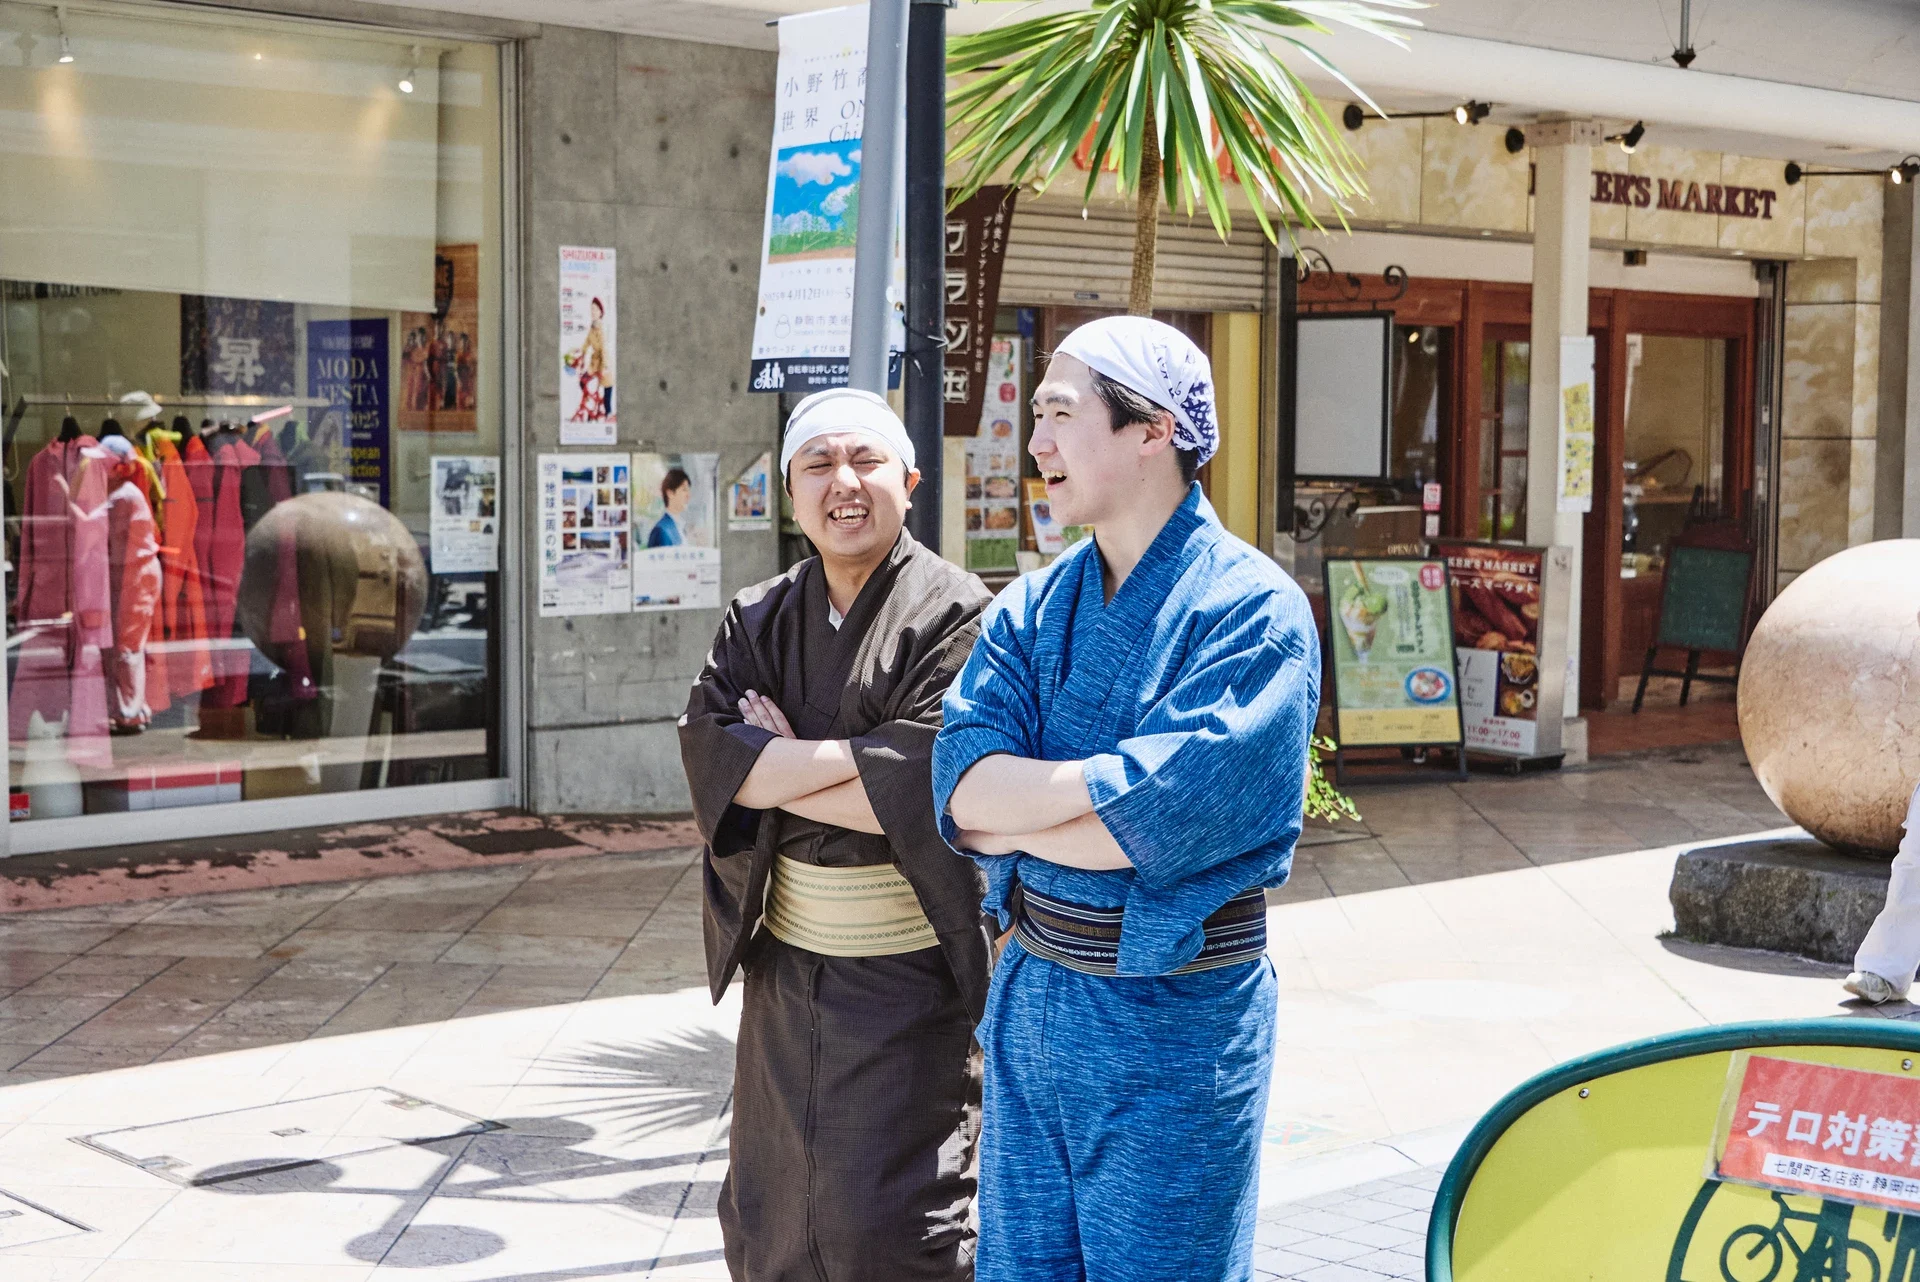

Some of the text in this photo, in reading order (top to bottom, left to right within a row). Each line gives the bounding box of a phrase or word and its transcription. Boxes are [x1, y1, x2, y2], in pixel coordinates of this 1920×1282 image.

[781, 106, 819, 132] 世界
[1590, 170, 1777, 219] ER'S MARKET
[316, 357, 379, 380] MODA
[317, 384, 379, 406] FESTA
[344, 410, 380, 430] 2025
[544, 482, 557, 576] 地球一周の船旅
[1483, 560, 1536, 575] MARKET
